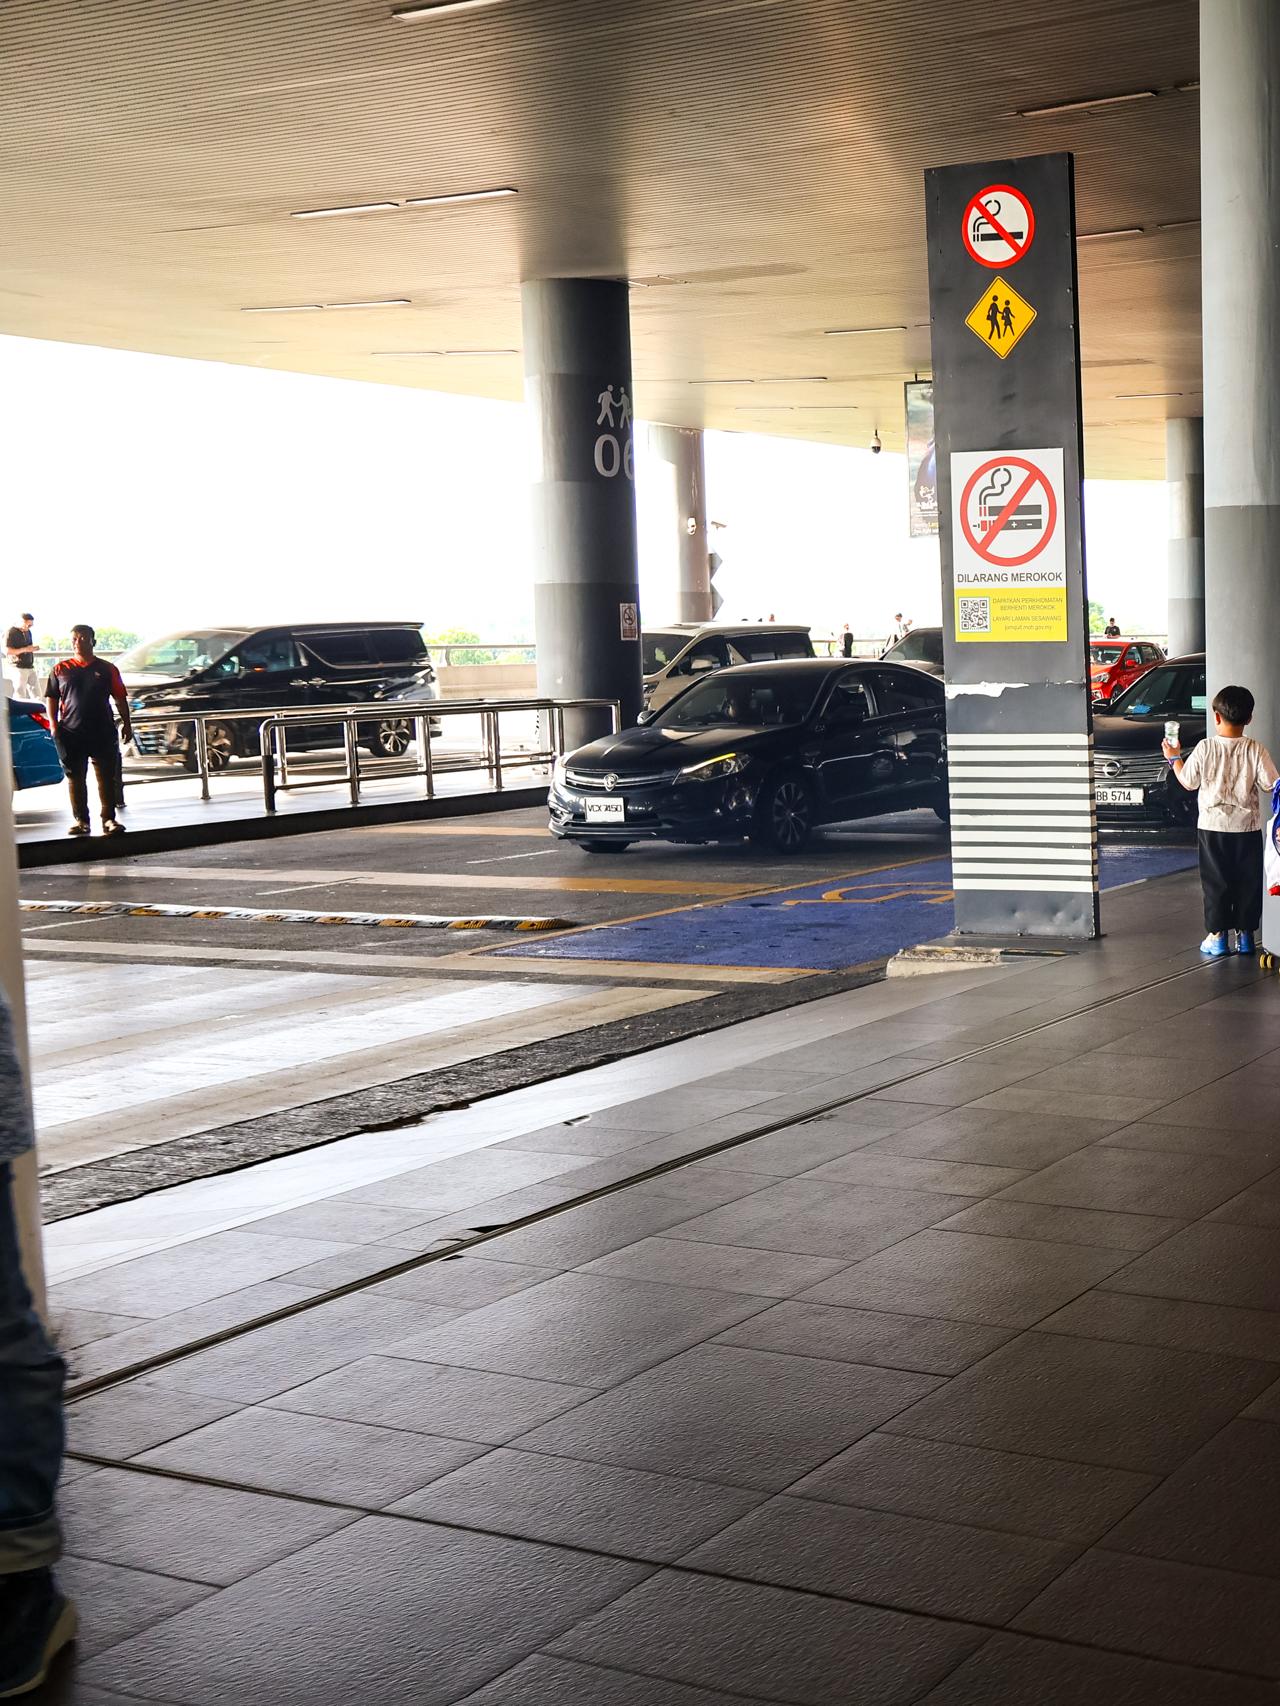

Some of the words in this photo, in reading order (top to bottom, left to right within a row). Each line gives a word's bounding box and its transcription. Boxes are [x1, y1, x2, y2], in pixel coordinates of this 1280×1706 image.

[957, 573, 1008, 583] DILARANG
[1011, 572, 1063, 582] MEROKOK
[1111, 791, 1132, 801] 5714
